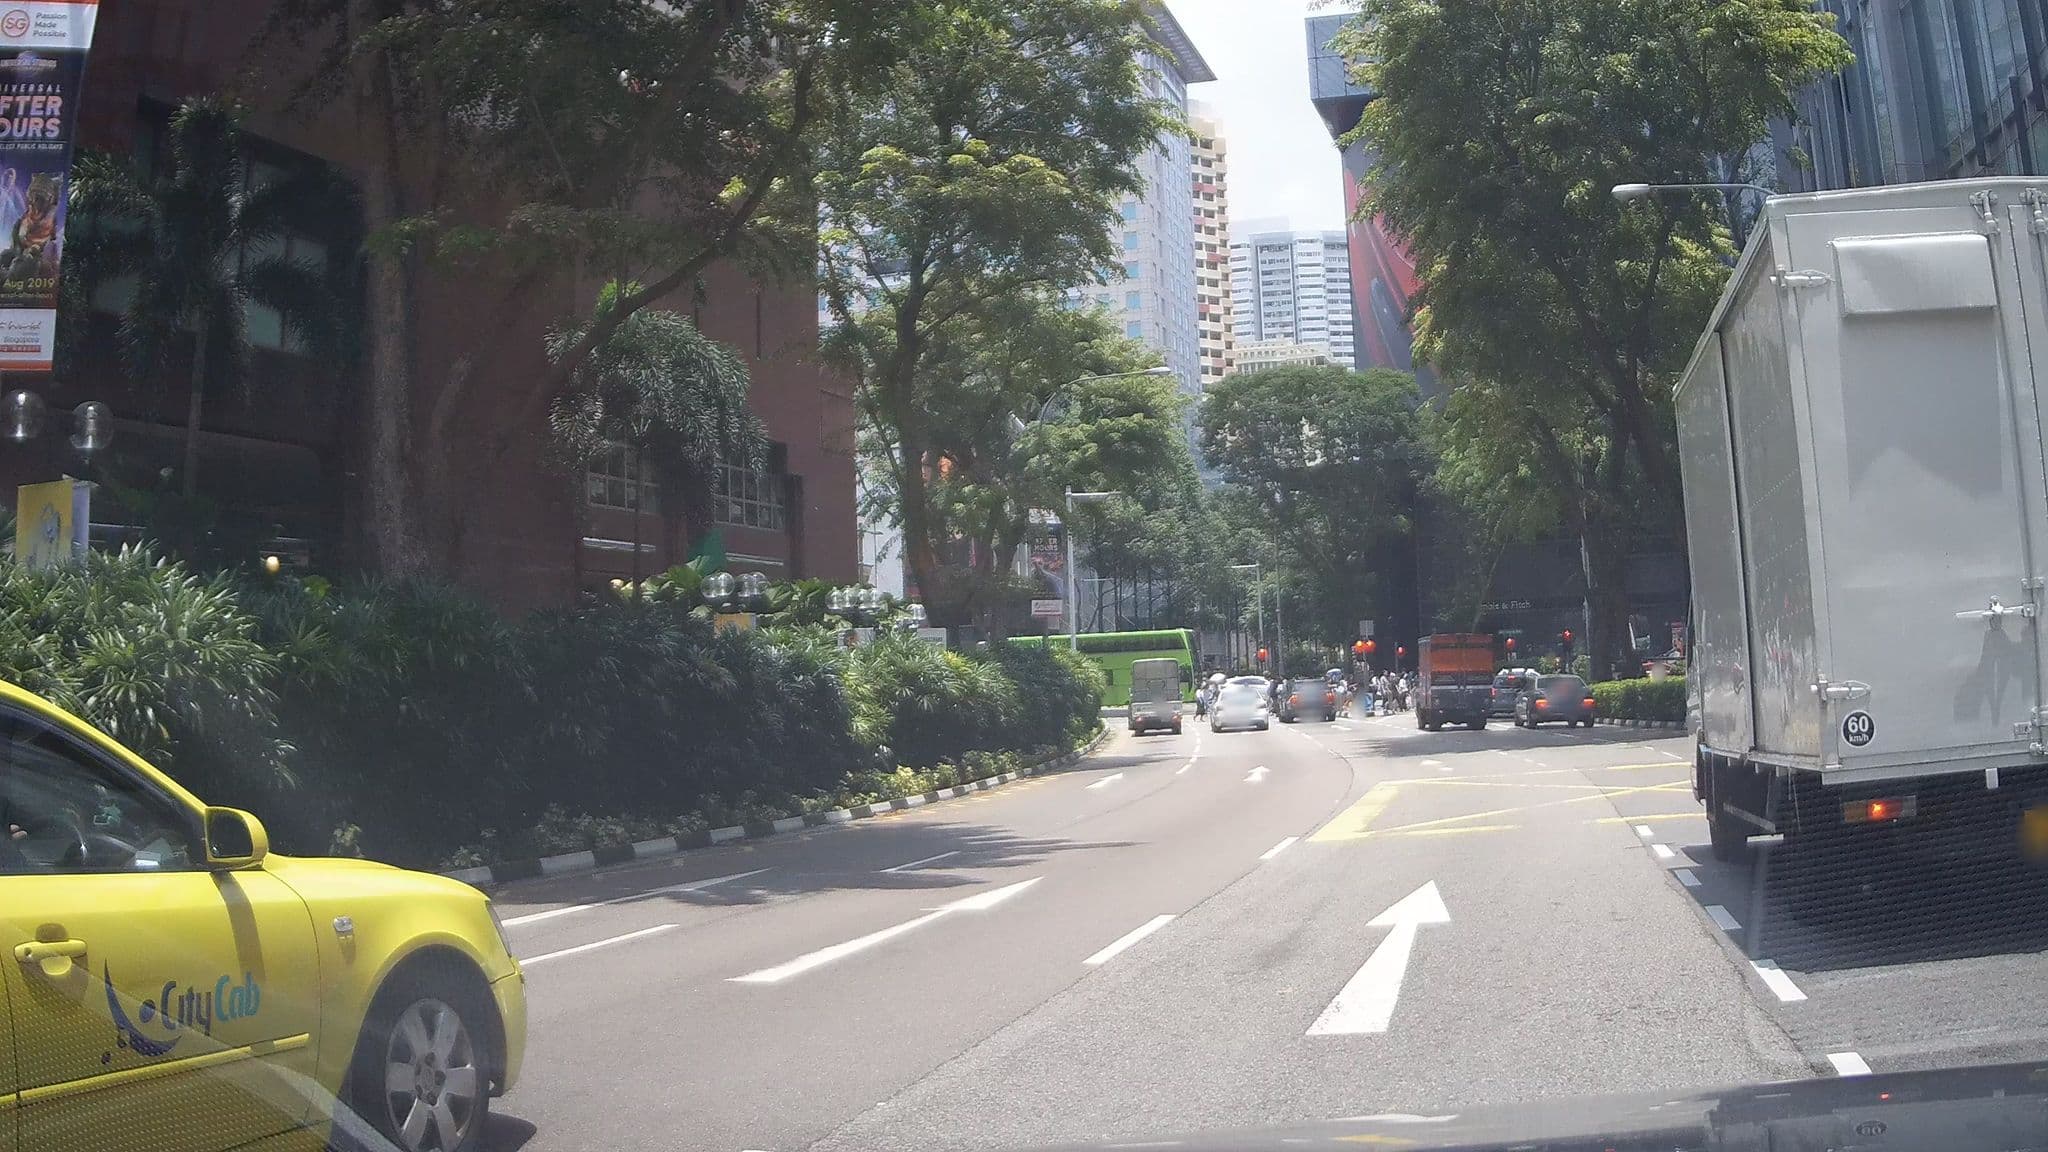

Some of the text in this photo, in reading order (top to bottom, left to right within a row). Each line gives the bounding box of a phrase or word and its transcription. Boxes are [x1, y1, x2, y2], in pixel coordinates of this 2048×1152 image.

[5, 17, 27, 30] SG
[32, 30, 68, 38] Possible
[0, 83, 61, 93] IVERSAL
[3, 277, 55, 290] Aug 2019
[1848, 715, 1869, 733] 60
[1849, 733, 1869, 742] km/h
[160, 972, 261, 1036] CityCab
